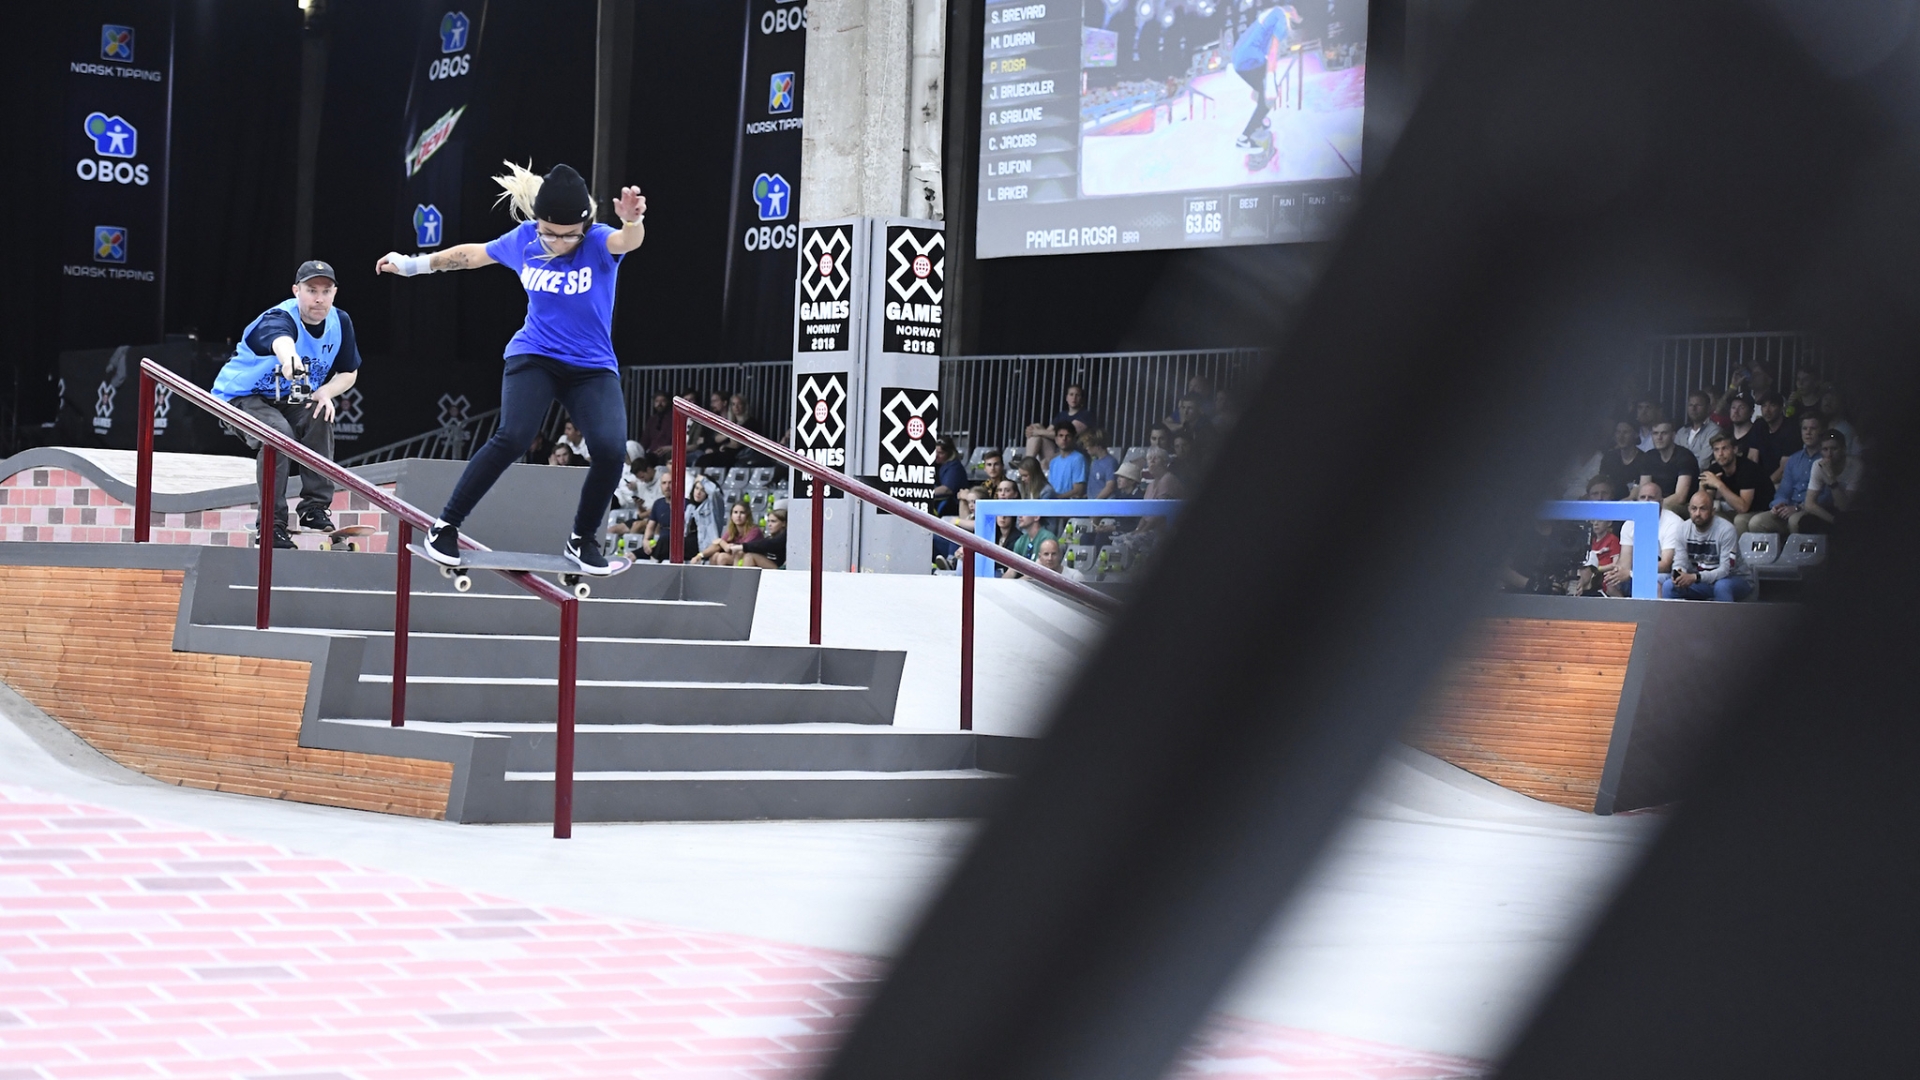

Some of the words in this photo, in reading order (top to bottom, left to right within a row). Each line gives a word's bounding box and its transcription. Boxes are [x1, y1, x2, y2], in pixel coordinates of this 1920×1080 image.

[991, 10, 1000, 24] S.
[1002, 4, 1046, 23] BREVARD
[990, 36, 1001, 50] M.
[1003, 31, 1036, 48] DURAN
[70, 61, 115, 77] NORSK
[116, 67, 162, 82] TIPPING
[429, 53, 471, 81] OBOS
[1001, 58, 1026, 73] ROSA
[990, 86, 999, 100] J.
[1000, 80, 1055, 99] BRUECKLER
[989, 111, 998, 125] A.
[1000, 107, 1043, 124] SABLONE
[746, 121, 778, 135] NORSK
[778, 117, 803, 131] TIPPIN
[988, 137, 998, 151] C.
[1000, 133, 1037, 150] JACOBS
[76, 157, 150, 186] OBOS
[998, 159, 1032, 175] BUFONI
[997, 185, 1028, 201] BAKER
[1190, 202, 1204, 212] FOR
[1239, 198, 1259, 209] BEST
[1185, 212, 1222, 234] 63.66
[744, 224, 797, 252] OBOS
[1026, 228, 1079, 249] PAMELA
[1081, 225, 1117, 246] ROSA
[1122, 231, 1140, 244] BRA
[63, 265, 106, 279] NORSK
[108, 268, 155, 282] TIPPING
[520, 265, 566, 294] NIKE
[564, 266, 593, 295] SB
[800, 300, 850, 321] GAMES
[885, 301, 942, 323] GAME
[806, 323, 841, 335] NORWAY
[895, 325, 942, 338] NORWAY
[811, 337, 835, 350] 2018
[903, 339, 935, 354] 2018
[334, 423, 365, 434] AMES
[880, 463, 935, 485] GAME
[806, 485, 831, 498] 28
[890, 486, 935, 499] NORWAY
